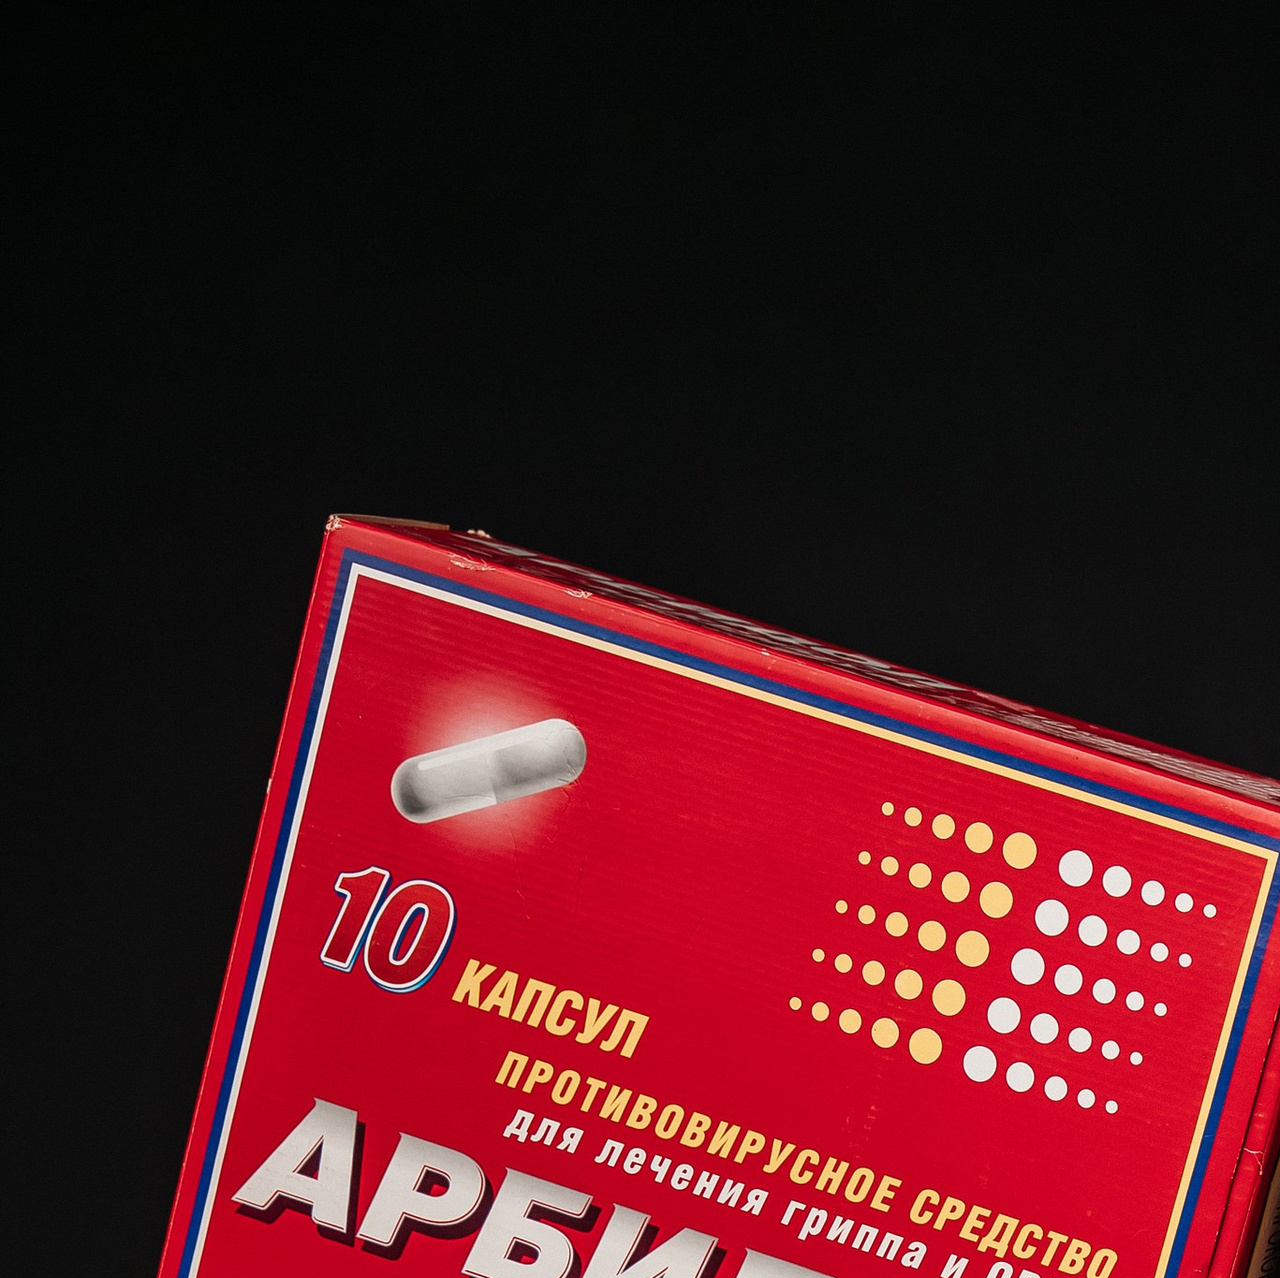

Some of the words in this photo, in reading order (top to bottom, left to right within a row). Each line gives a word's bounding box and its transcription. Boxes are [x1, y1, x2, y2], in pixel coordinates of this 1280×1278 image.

[320, 866, 457, 993] 10
[451, 958, 650, 1058] КАПСУЛ
[494, 1050, 903, 1213] ПРОТИВОВИРУСНОЕ
[503, 1109, 584, 1154] для
[594, 1138, 769, 1216] лечения
[780, 1200, 928, 1270] гриппа
